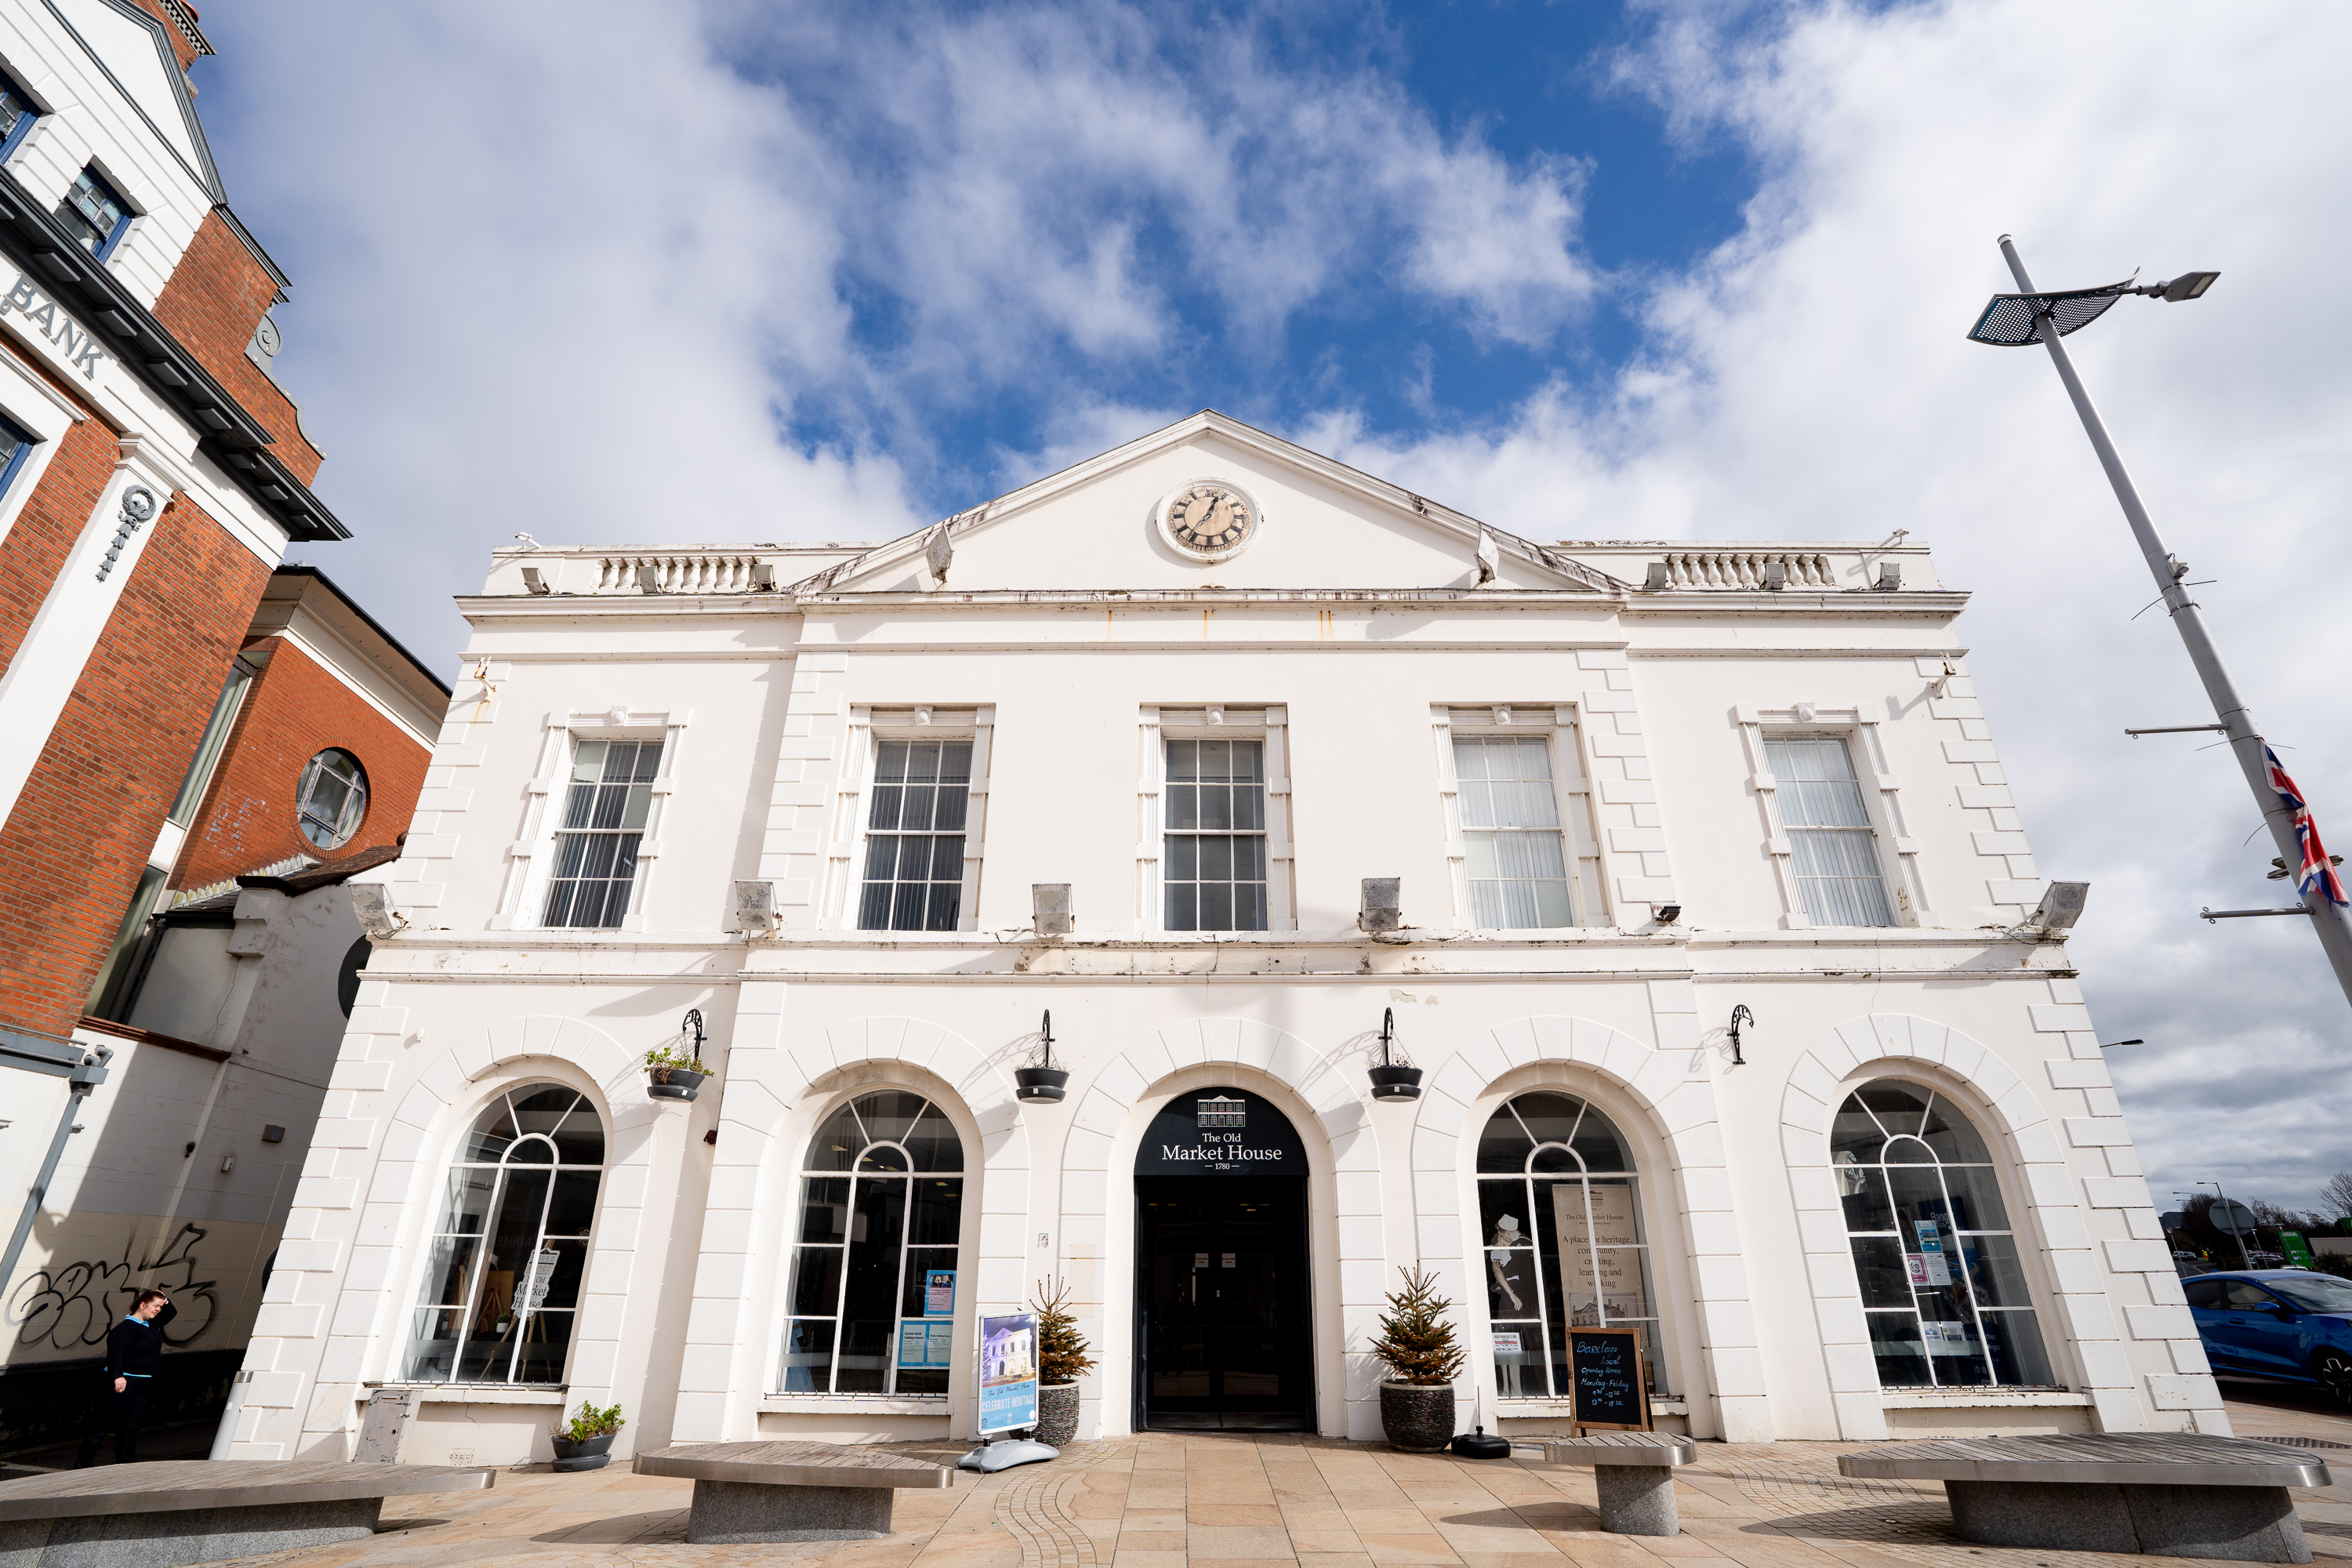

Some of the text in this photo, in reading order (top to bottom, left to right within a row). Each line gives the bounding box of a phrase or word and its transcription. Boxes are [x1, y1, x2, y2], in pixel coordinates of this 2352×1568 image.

[3, 271, 105, 382] BANK
[1202, 1133, 1241, 1142] The Old
[1162, 1145, 1282, 1160] Market House
[1930, 1212, 1951, 1225] Bang
[1570, 1236, 1588, 1245] place
[1602, 1236, 1633, 1245] heritage,
[1584, 1258, 1615, 1266] crting,
[1609, 1268, 1622, 1276] and
[516, 1283, 547, 1296] Mrket
[1600, 1355, 1621, 1365] Local
[1581, 1367, 1604, 1377] Opening
[1006, 1385, 1021, 1394] Market
[982, 1393, 1036, 1413] CELEBRATE HERITAGE
